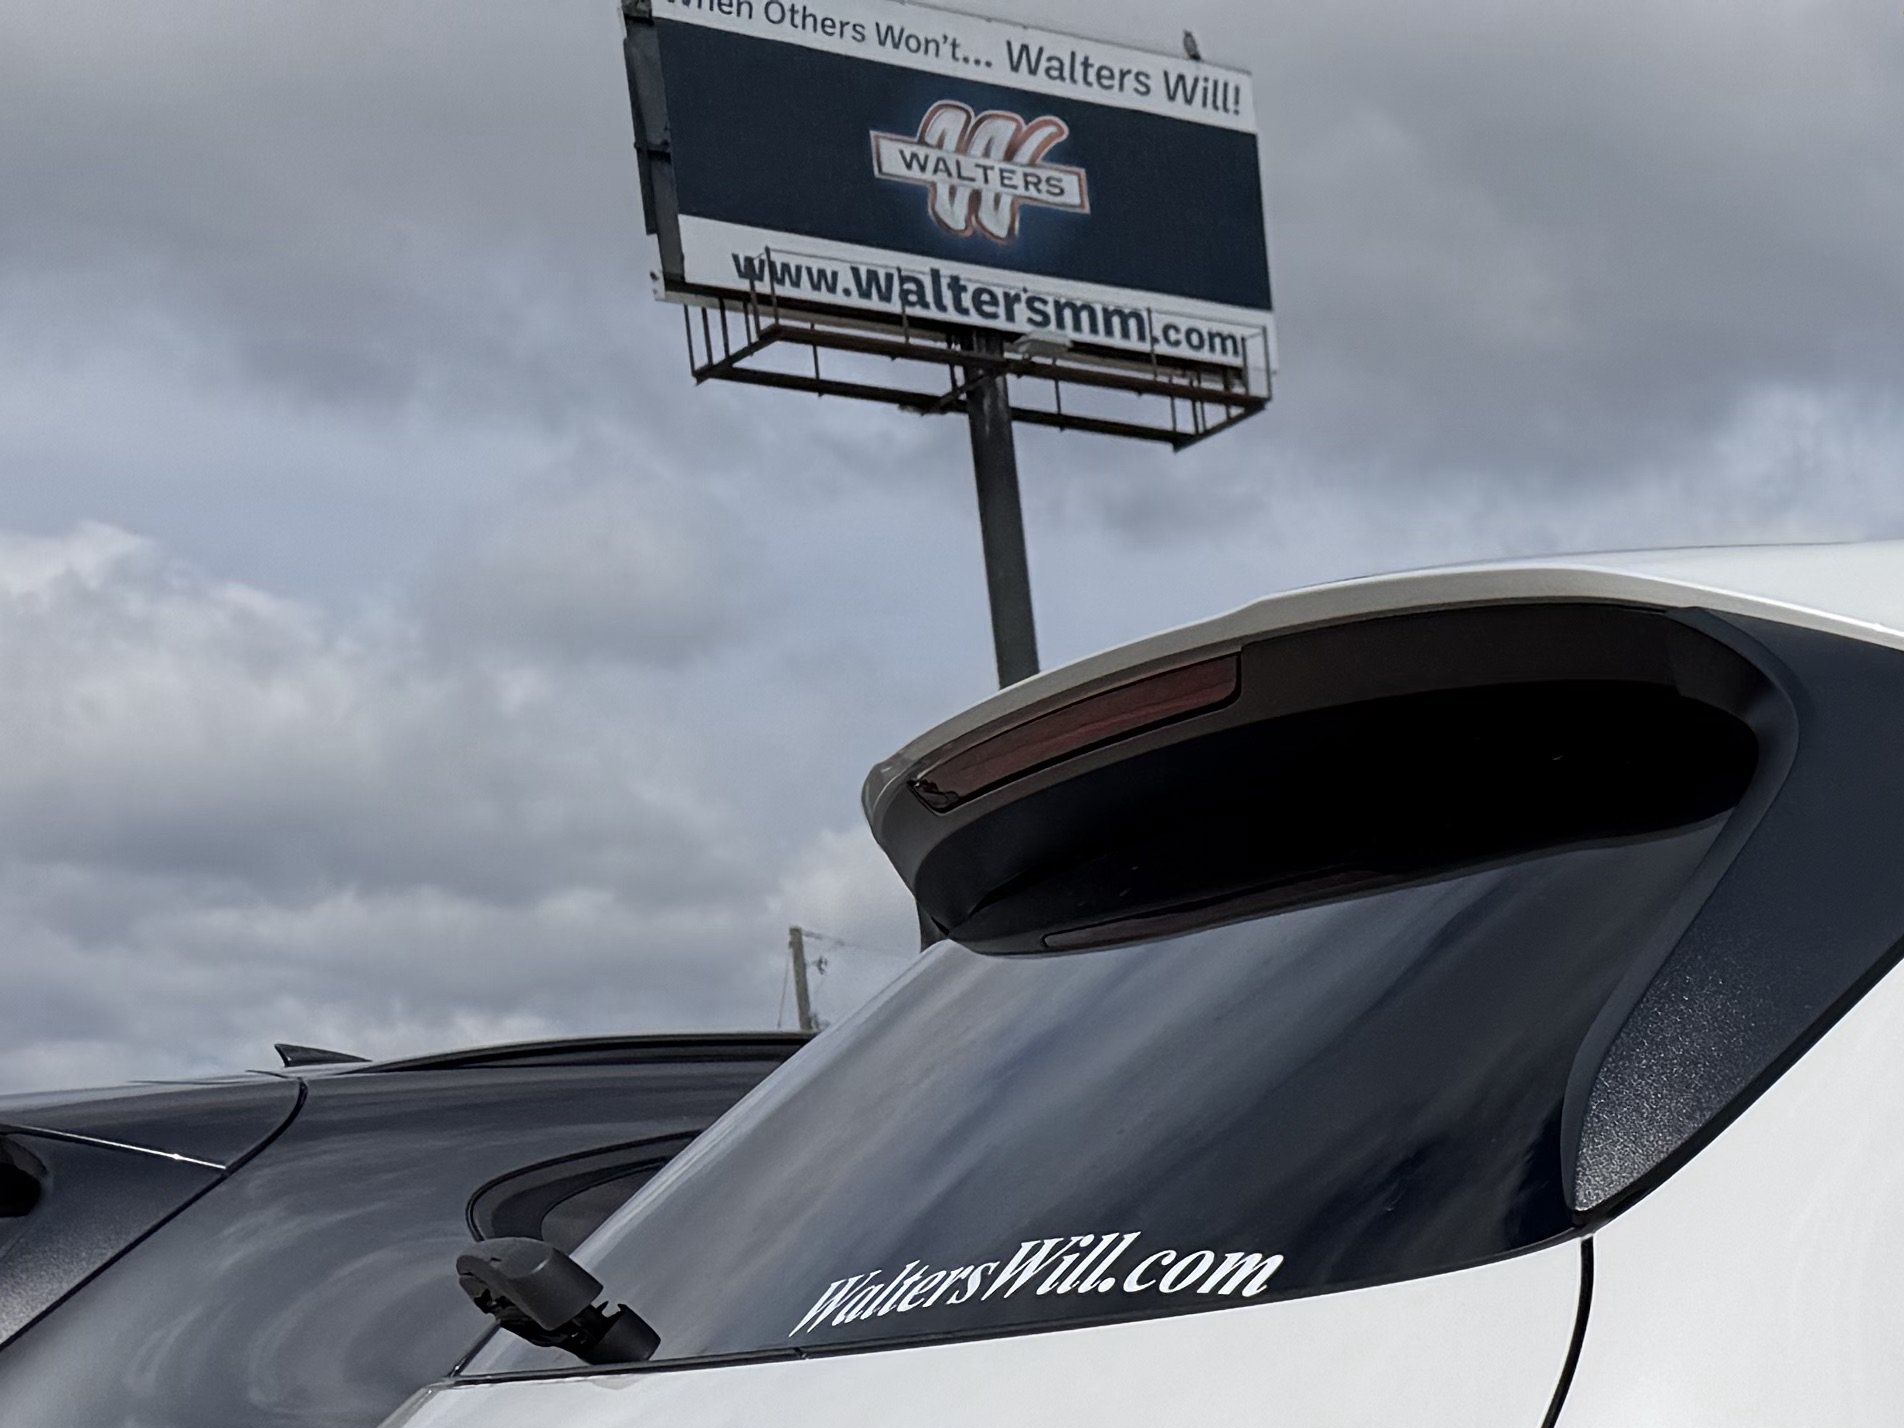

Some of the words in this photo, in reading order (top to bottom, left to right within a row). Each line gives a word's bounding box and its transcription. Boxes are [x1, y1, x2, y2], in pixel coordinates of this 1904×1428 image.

[763, 0, 867, 43] Others
[1005, 39, 1152, 97] Walters
[1162, 69, 1242, 117] Will!
[898, 148, 1067, 199] WALTERS
[731, 250, 1242, 359] www.waltersmm.com
[788, 1230, 1285, 1338] WaltersWill.com
